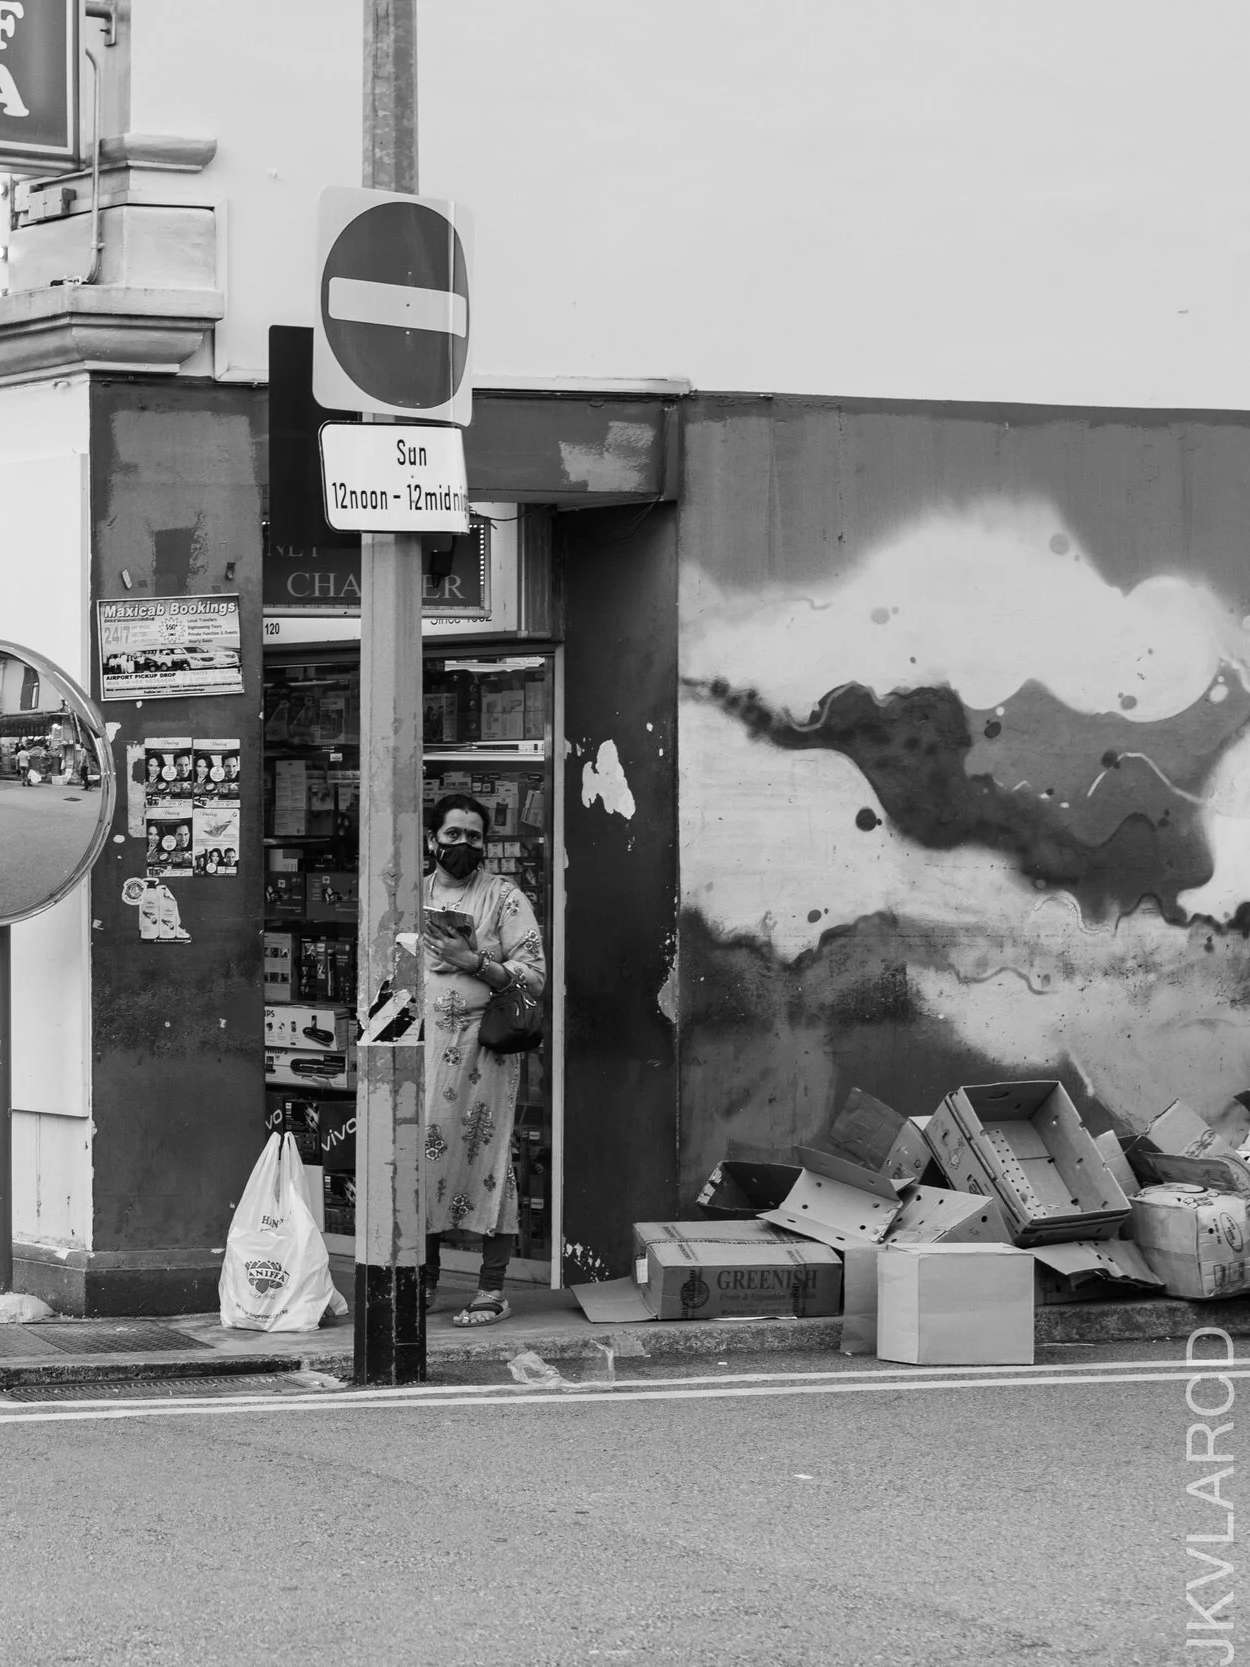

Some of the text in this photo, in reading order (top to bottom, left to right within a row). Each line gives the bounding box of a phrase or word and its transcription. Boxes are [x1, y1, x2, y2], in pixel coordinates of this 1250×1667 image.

[397, 439, 427, 466] Sun
[332, 482, 388, 510] 12noon
[406, 484, 469, 512] 12midni
[287, 571, 466, 599] CHAER
[104, 600, 236, 618] Maxicab Bookings
[105, 625, 130, 644] 24/7
[264, 623, 280, 635] 120
[321, 1117, 357, 1152] vivo
[249, 1269, 285, 1283] ANIFFA
[717, 1269, 818, 1290] GREENISH
